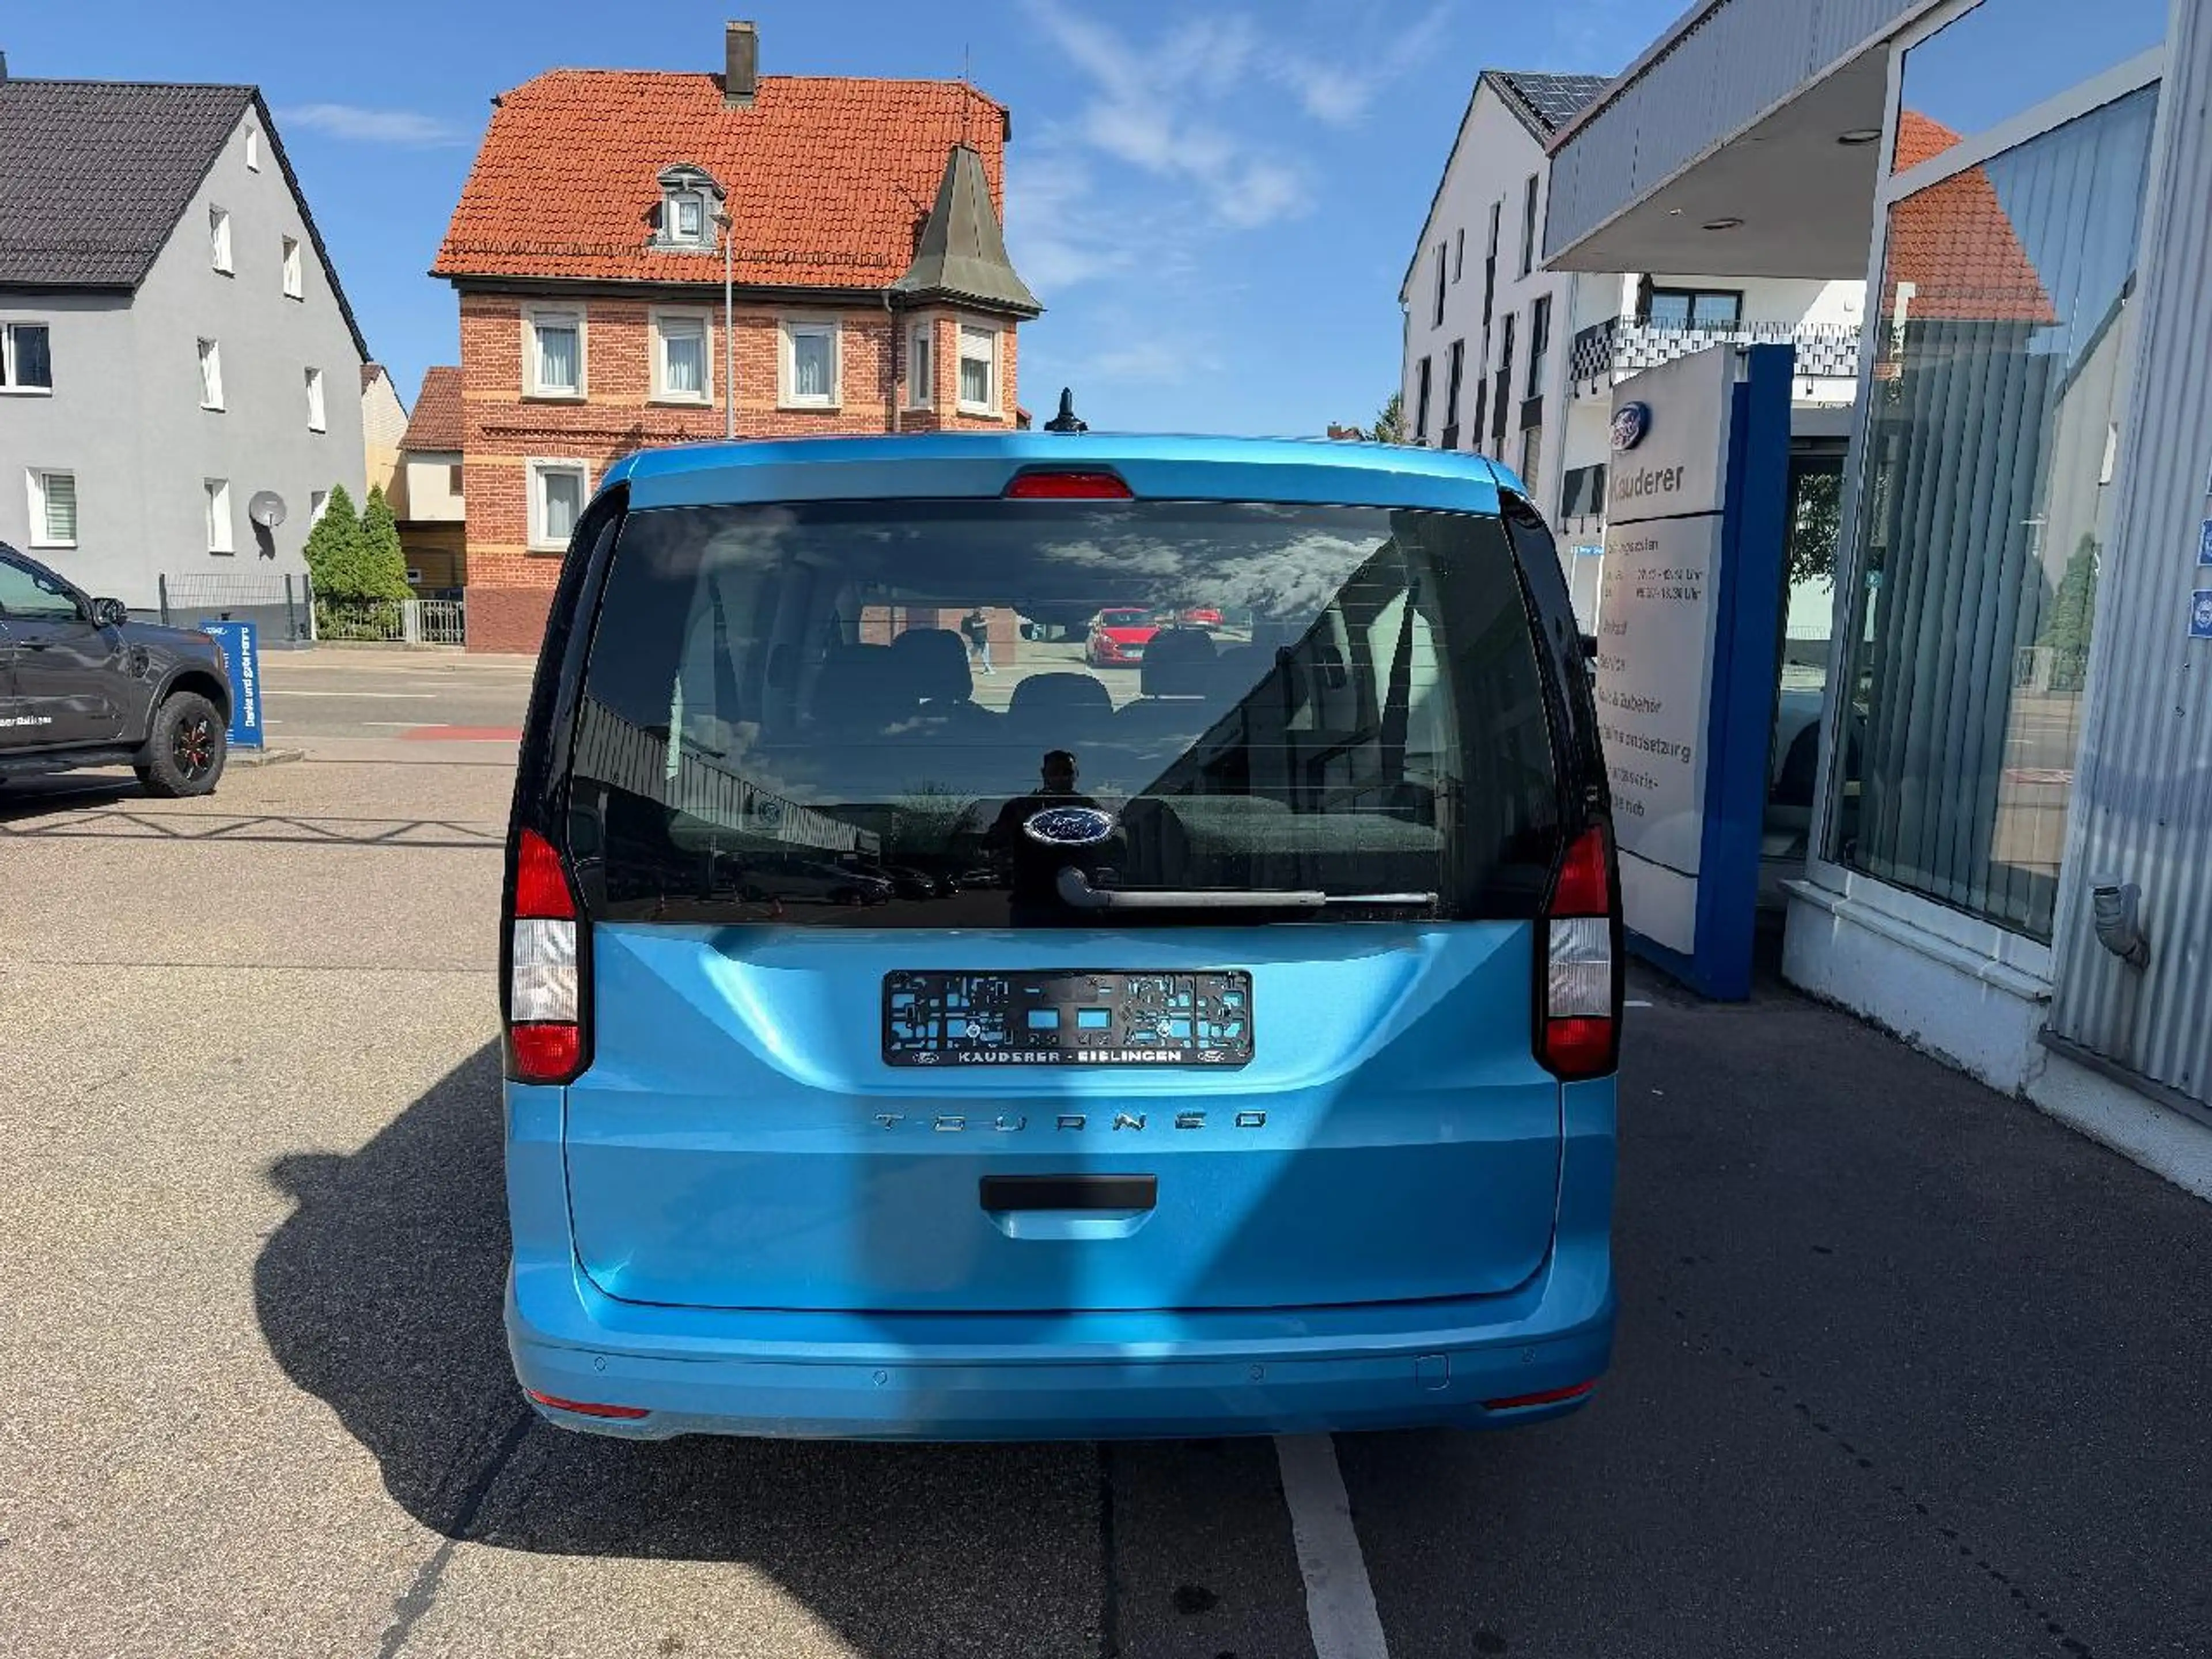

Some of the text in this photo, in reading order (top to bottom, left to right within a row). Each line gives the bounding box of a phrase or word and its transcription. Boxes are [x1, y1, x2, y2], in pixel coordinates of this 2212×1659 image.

[958, 1052, 1060, 1062] KAUDERER
[1078, 1051, 1181, 1062] EISLINGEN
[874, 1111, 1267, 1131] TOURNEO
